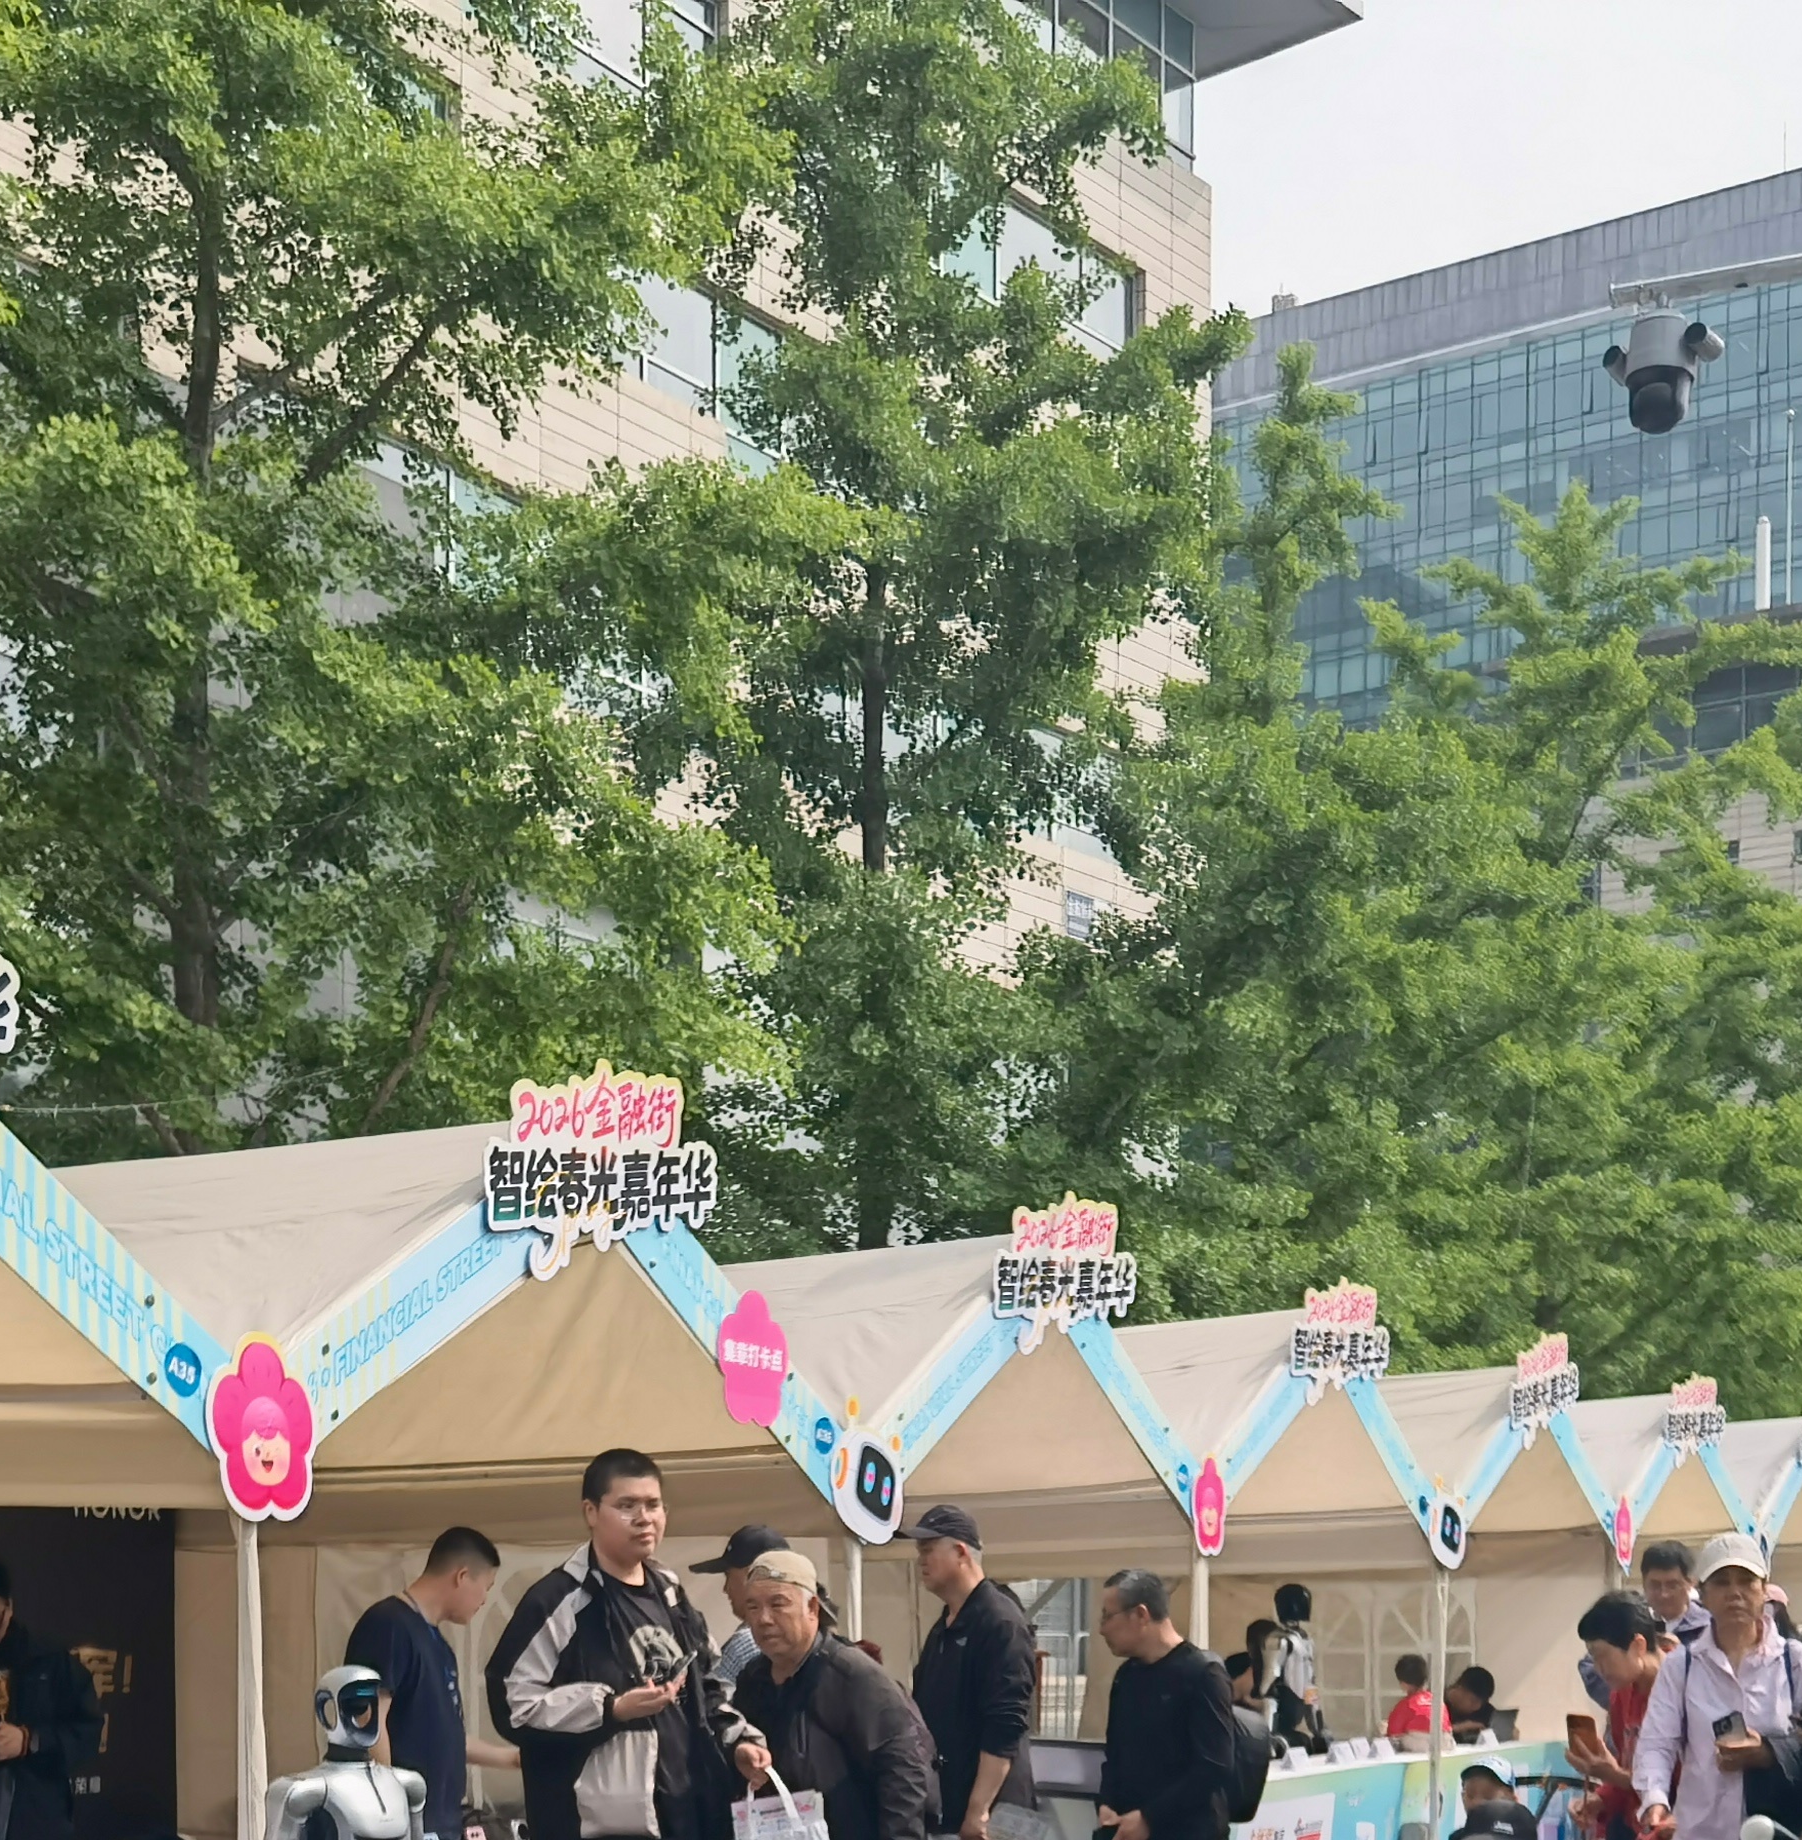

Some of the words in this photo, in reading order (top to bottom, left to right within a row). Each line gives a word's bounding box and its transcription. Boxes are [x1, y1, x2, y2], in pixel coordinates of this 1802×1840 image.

[517, 1071, 677, 1149] 2026金融街
[488, 1145, 713, 1226] 智绘春光嘉年华
[44, 1218, 145, 1342] STREET
[333, 1279, 434, 1386] FINANCIAL
